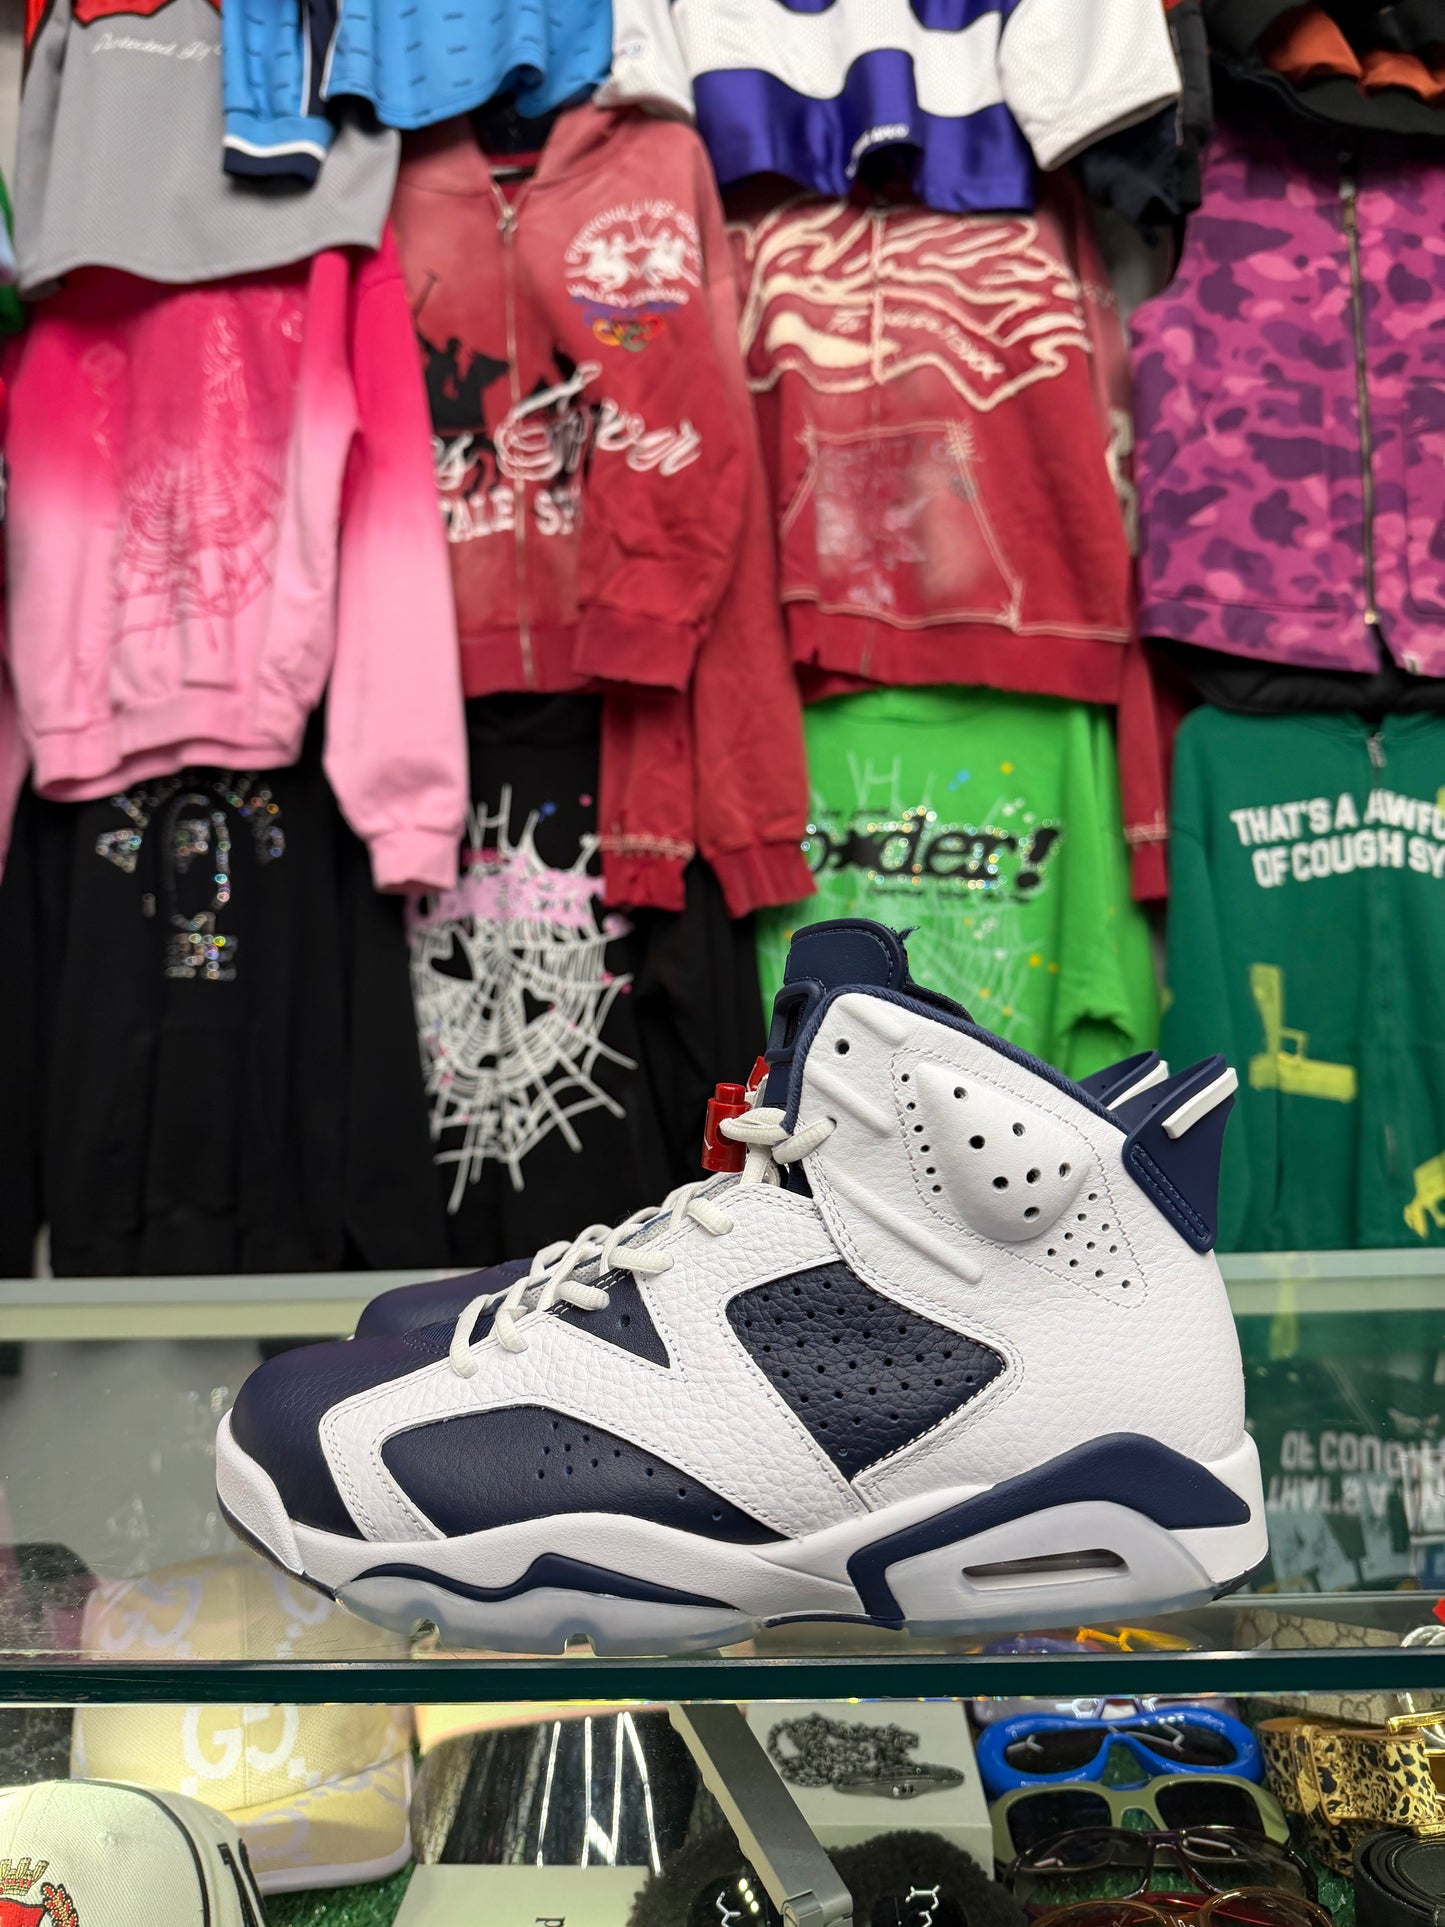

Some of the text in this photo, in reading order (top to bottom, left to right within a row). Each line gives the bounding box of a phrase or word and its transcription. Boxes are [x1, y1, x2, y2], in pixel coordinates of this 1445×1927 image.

[1229, 798, 1332, 846] THAT'S
[1333, 792, 1360, 830] A
[1252, 845, 1290, 889] OF
[1291, 828, 1406, 882] COUGH
